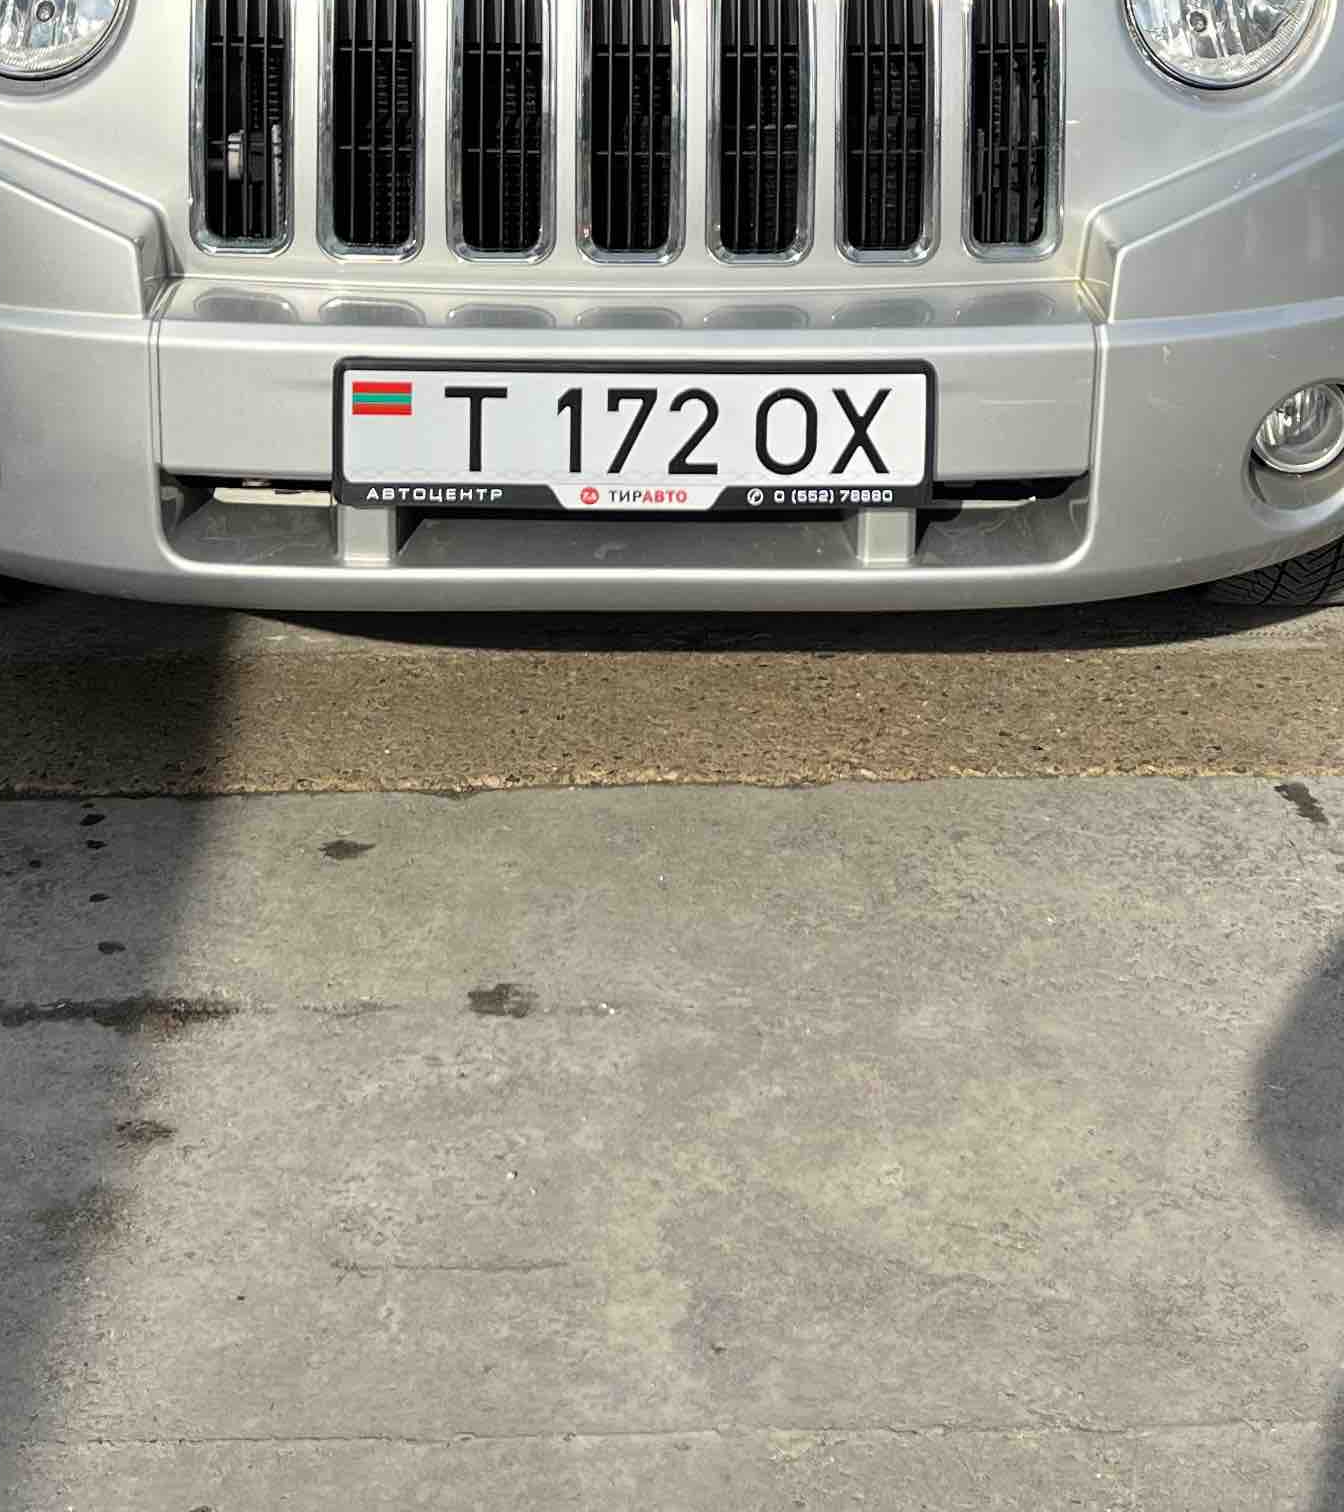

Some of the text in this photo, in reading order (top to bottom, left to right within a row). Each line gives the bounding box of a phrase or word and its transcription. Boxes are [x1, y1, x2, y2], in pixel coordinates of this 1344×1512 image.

[445, 386, 892, 475] T 172 OX
[366, 488, 503, 504] АВТОЦЕНТР
[608, 489, 688, 504] ТИРАВТО
